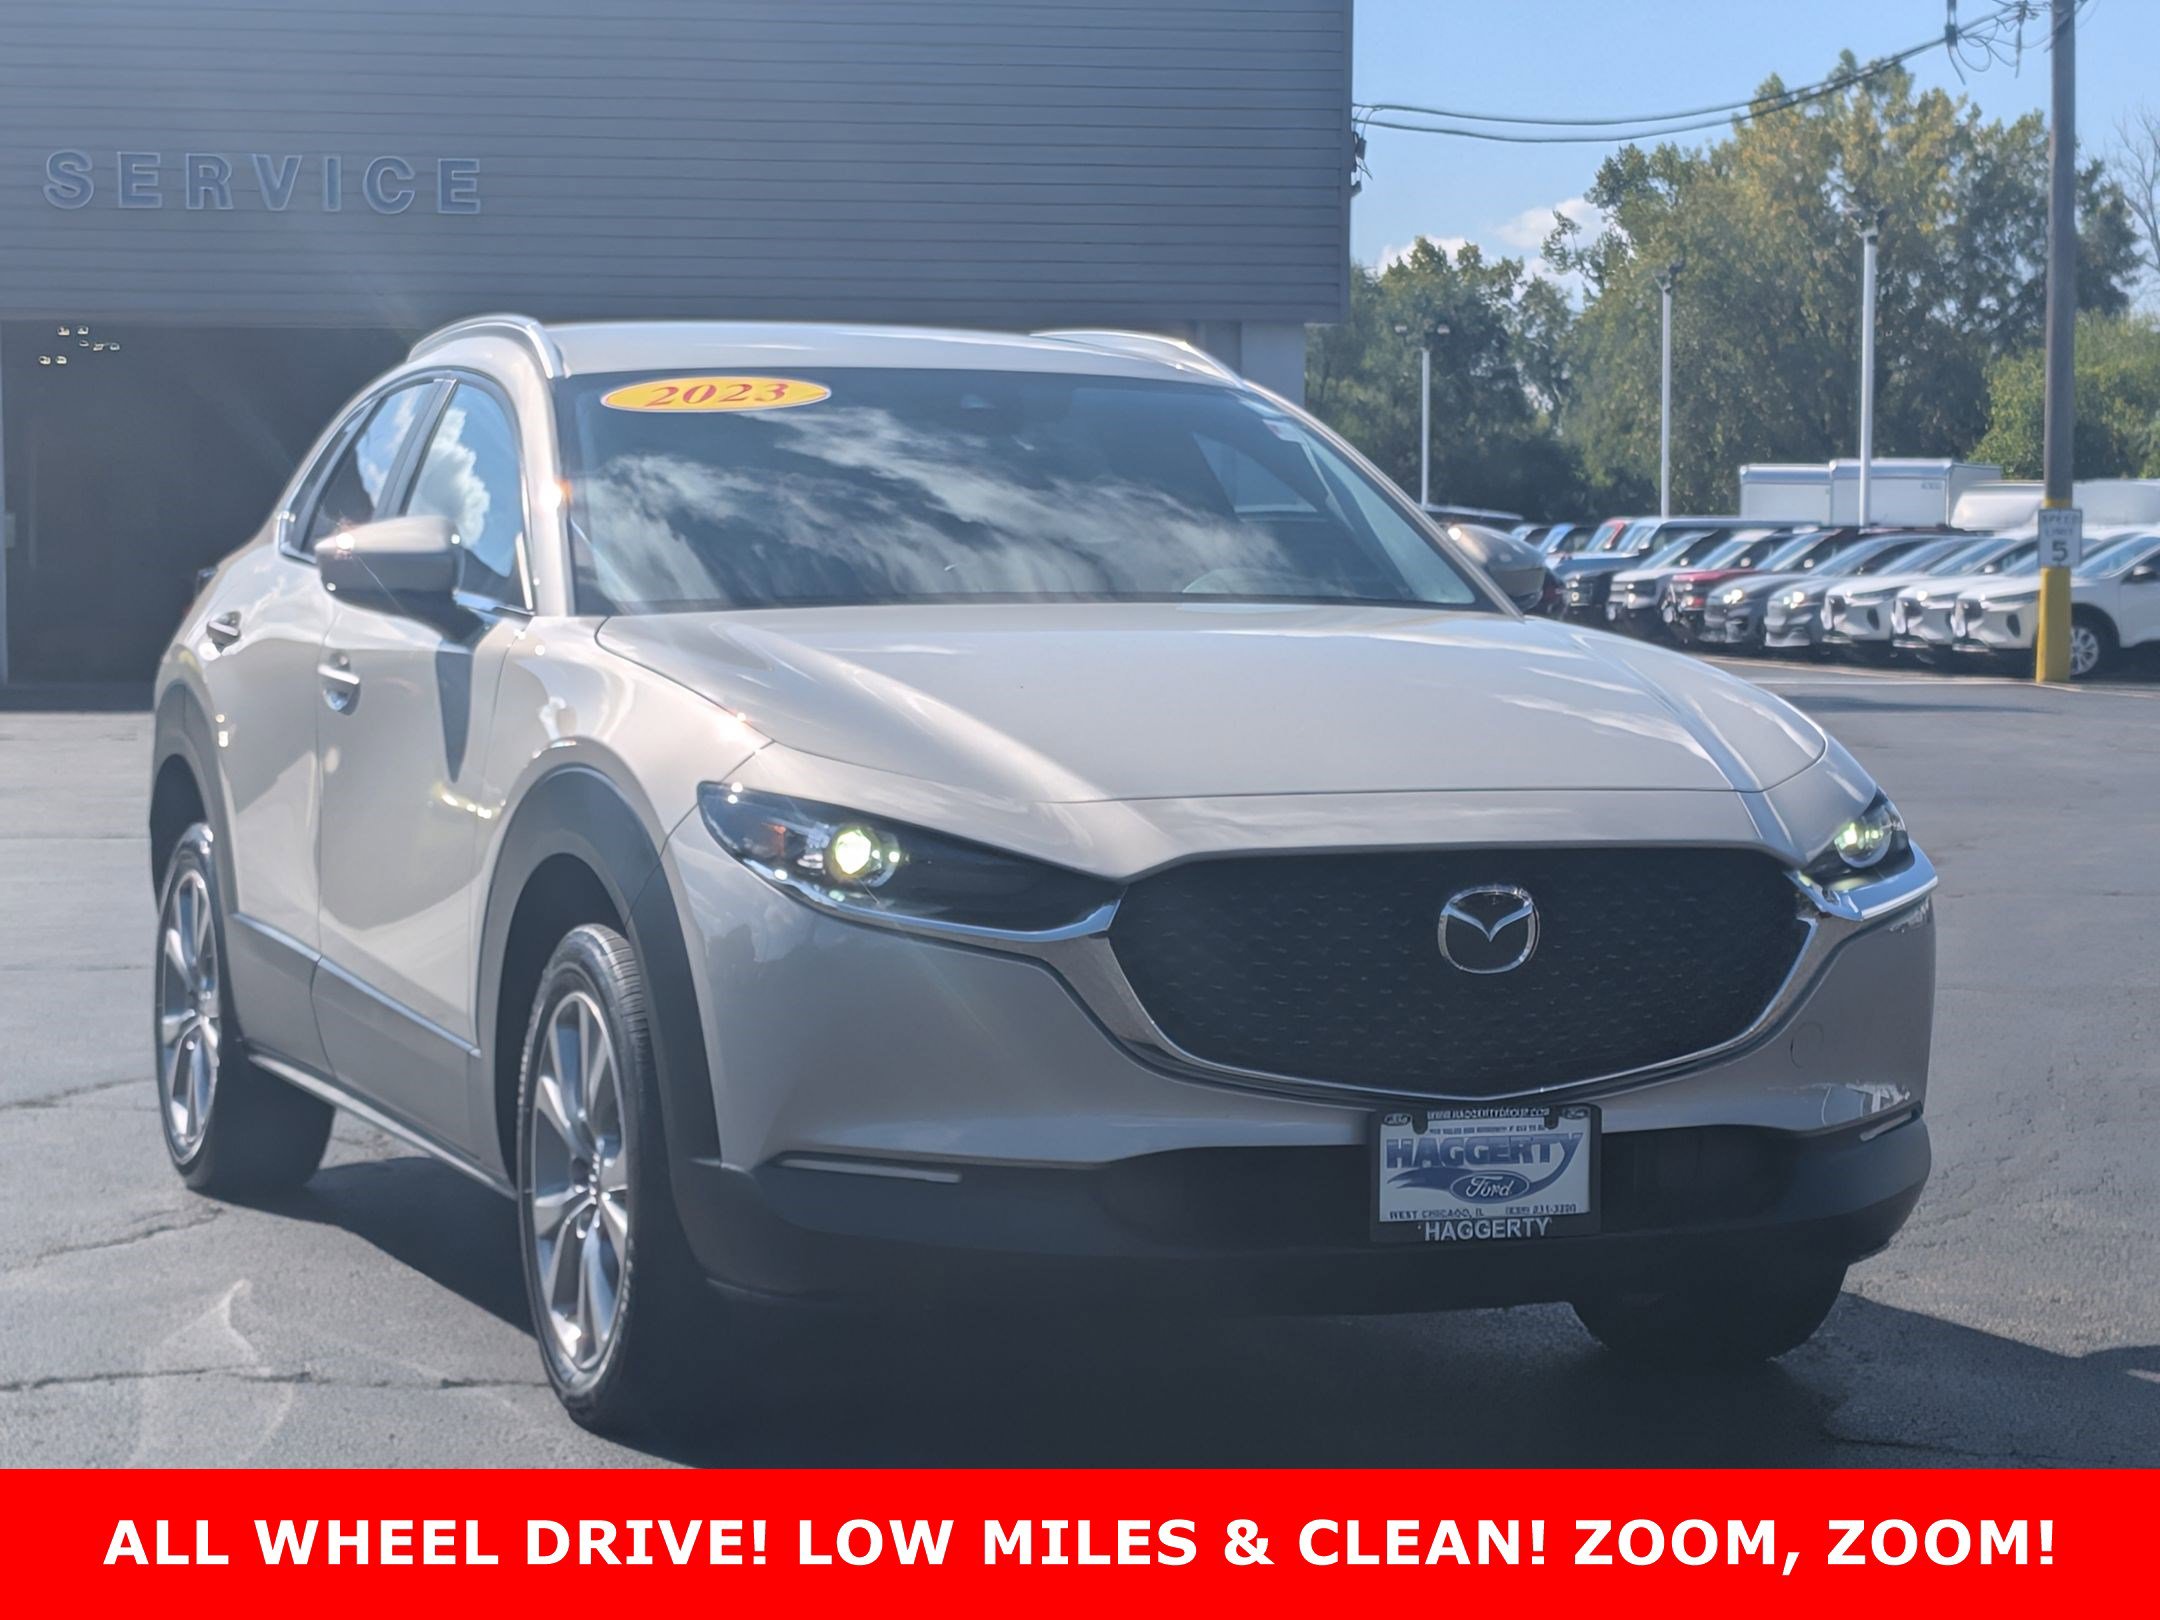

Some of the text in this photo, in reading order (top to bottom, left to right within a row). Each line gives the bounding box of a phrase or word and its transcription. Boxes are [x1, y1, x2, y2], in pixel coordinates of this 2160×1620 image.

[42, 149, 482, 215] SERVICE
[645, 383, 789, 407] 2023
[2052, 540, 2068, 561] 5
[1386, 1132, 1584, 1169] HAGGERTY
[1465, 1177, 1514, 1198] Ford
[1424, 1217, 1550, 1241] HAGGERTY
